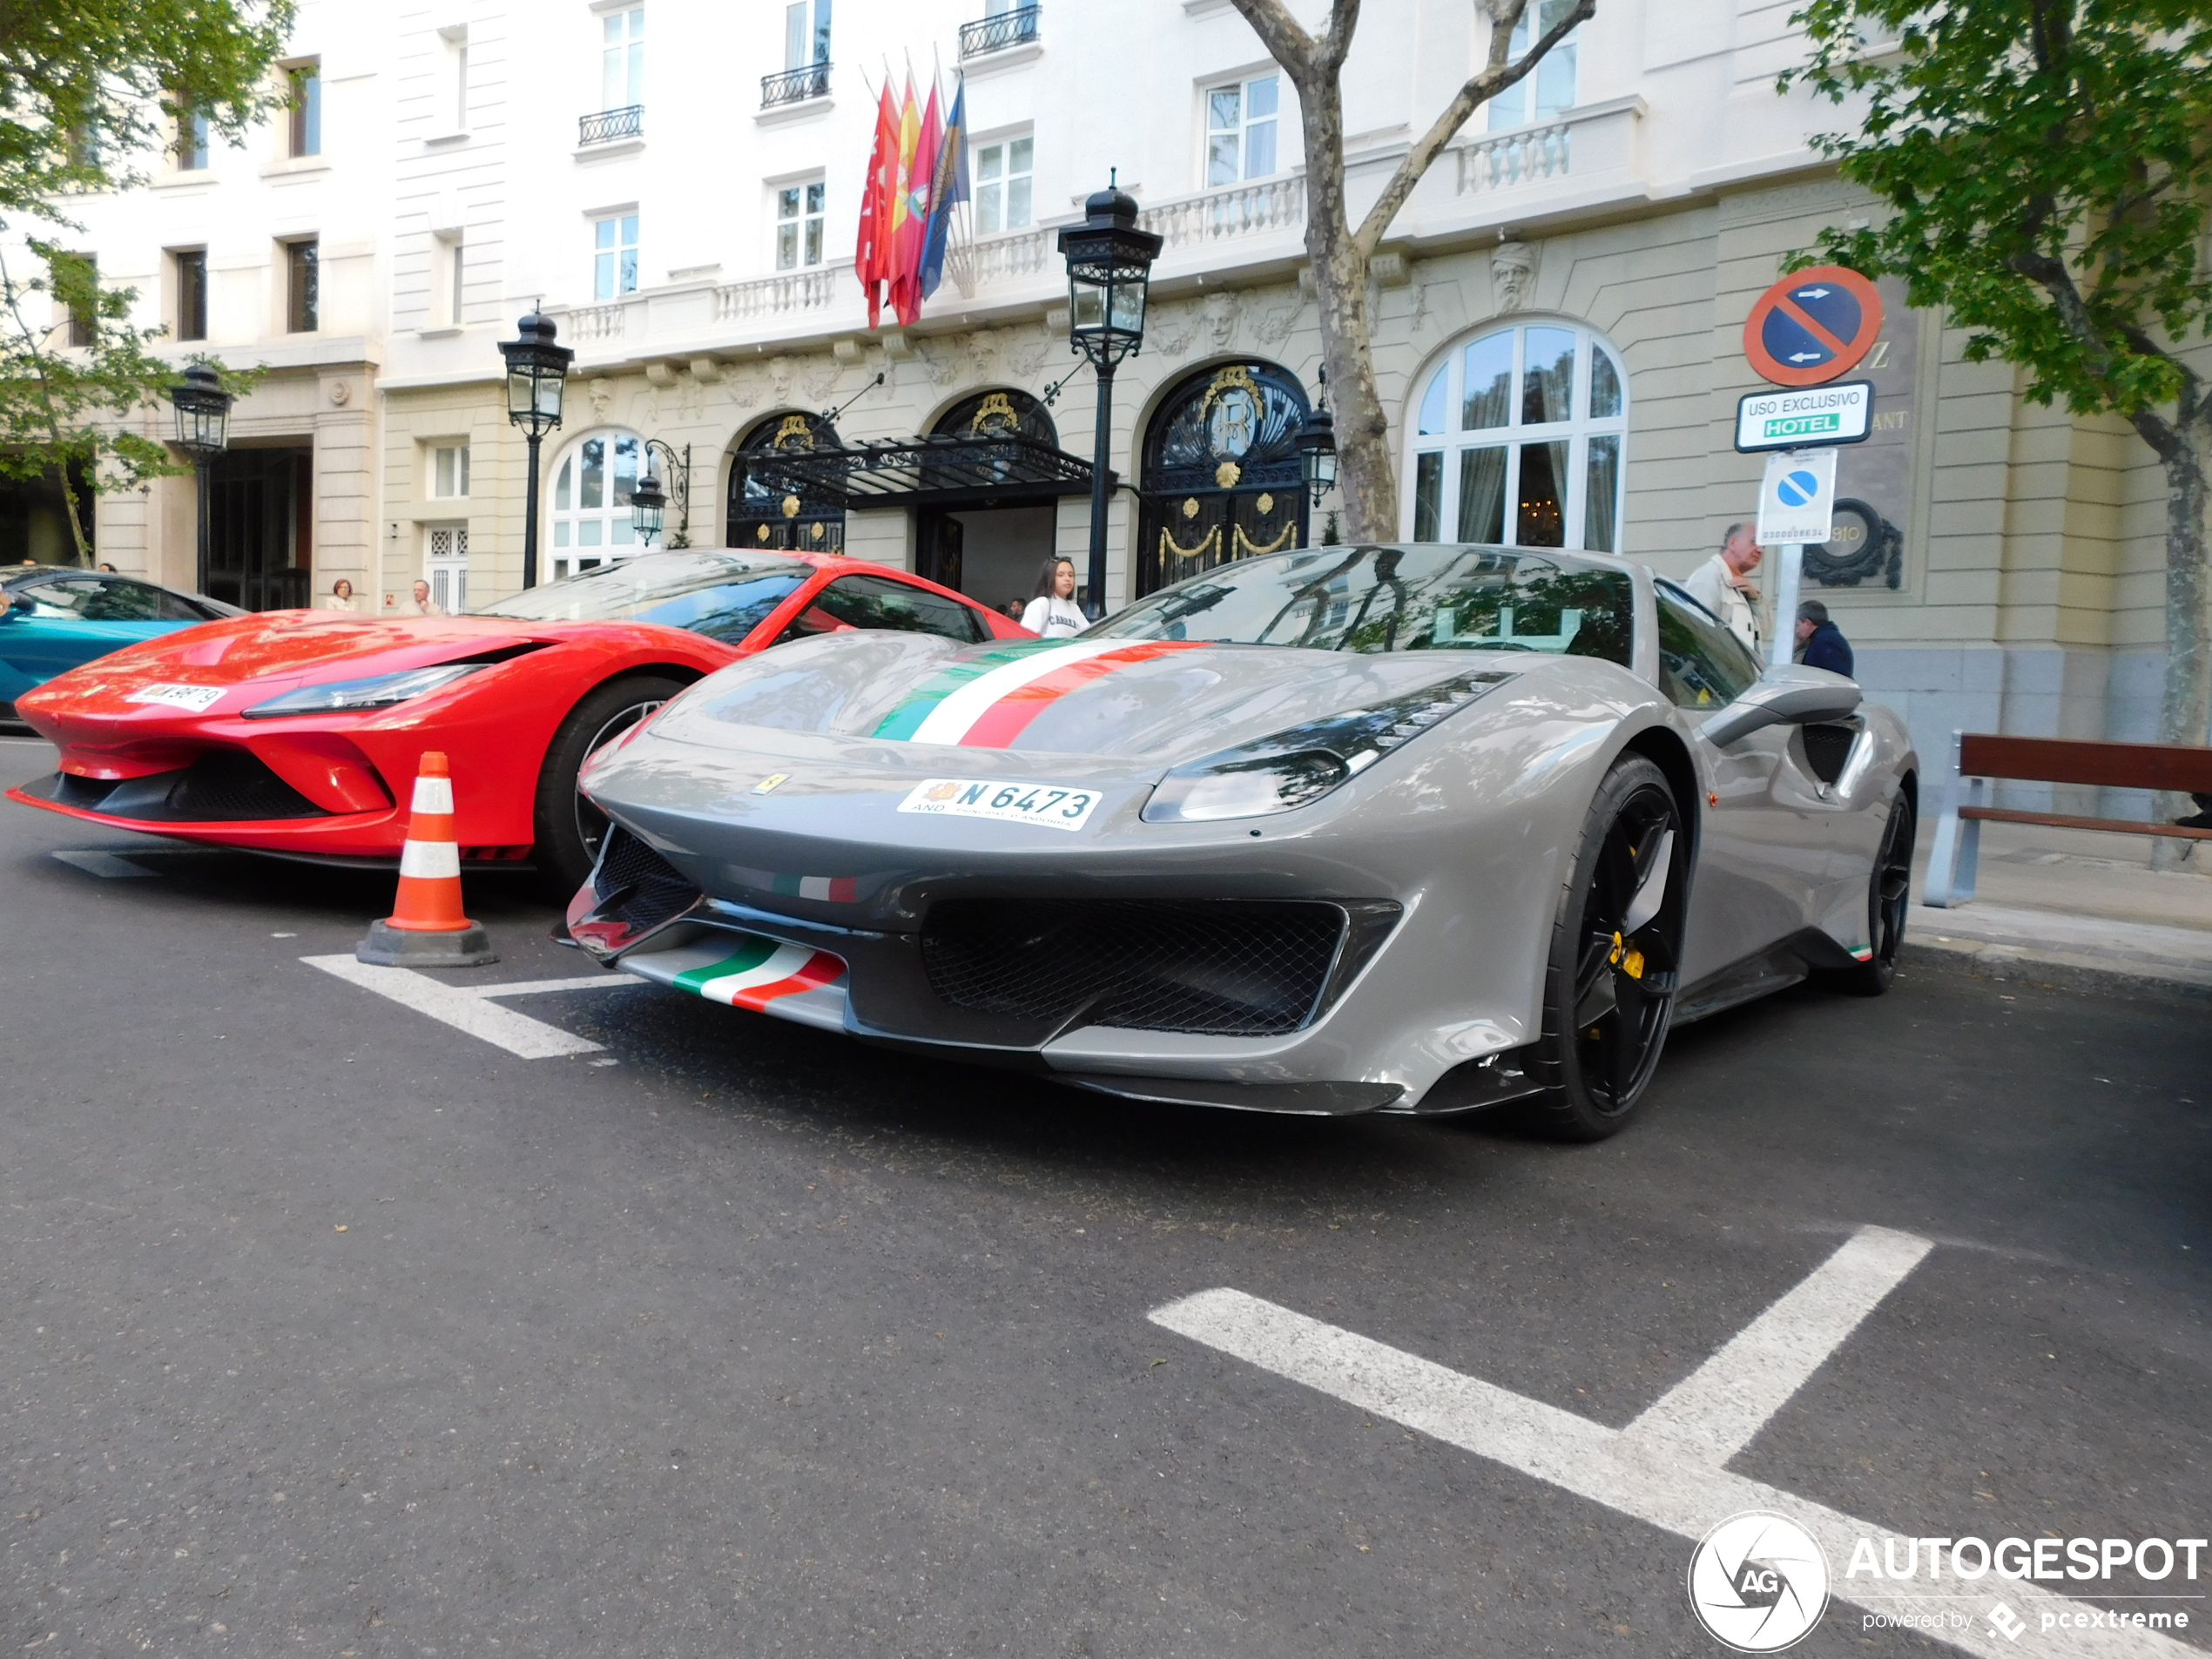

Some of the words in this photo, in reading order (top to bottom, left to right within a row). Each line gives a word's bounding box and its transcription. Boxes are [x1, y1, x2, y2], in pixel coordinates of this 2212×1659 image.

[1750, 401, 1777, 416] USO
[1783, 392, 1860, 412] EXCLUSIVO
[1766, 416, 1837, 435] HOTEL
[912, 803, 945, 813] AND
[956, 784, 990, 806] N
[990, 787, 1091, 819] 6473
